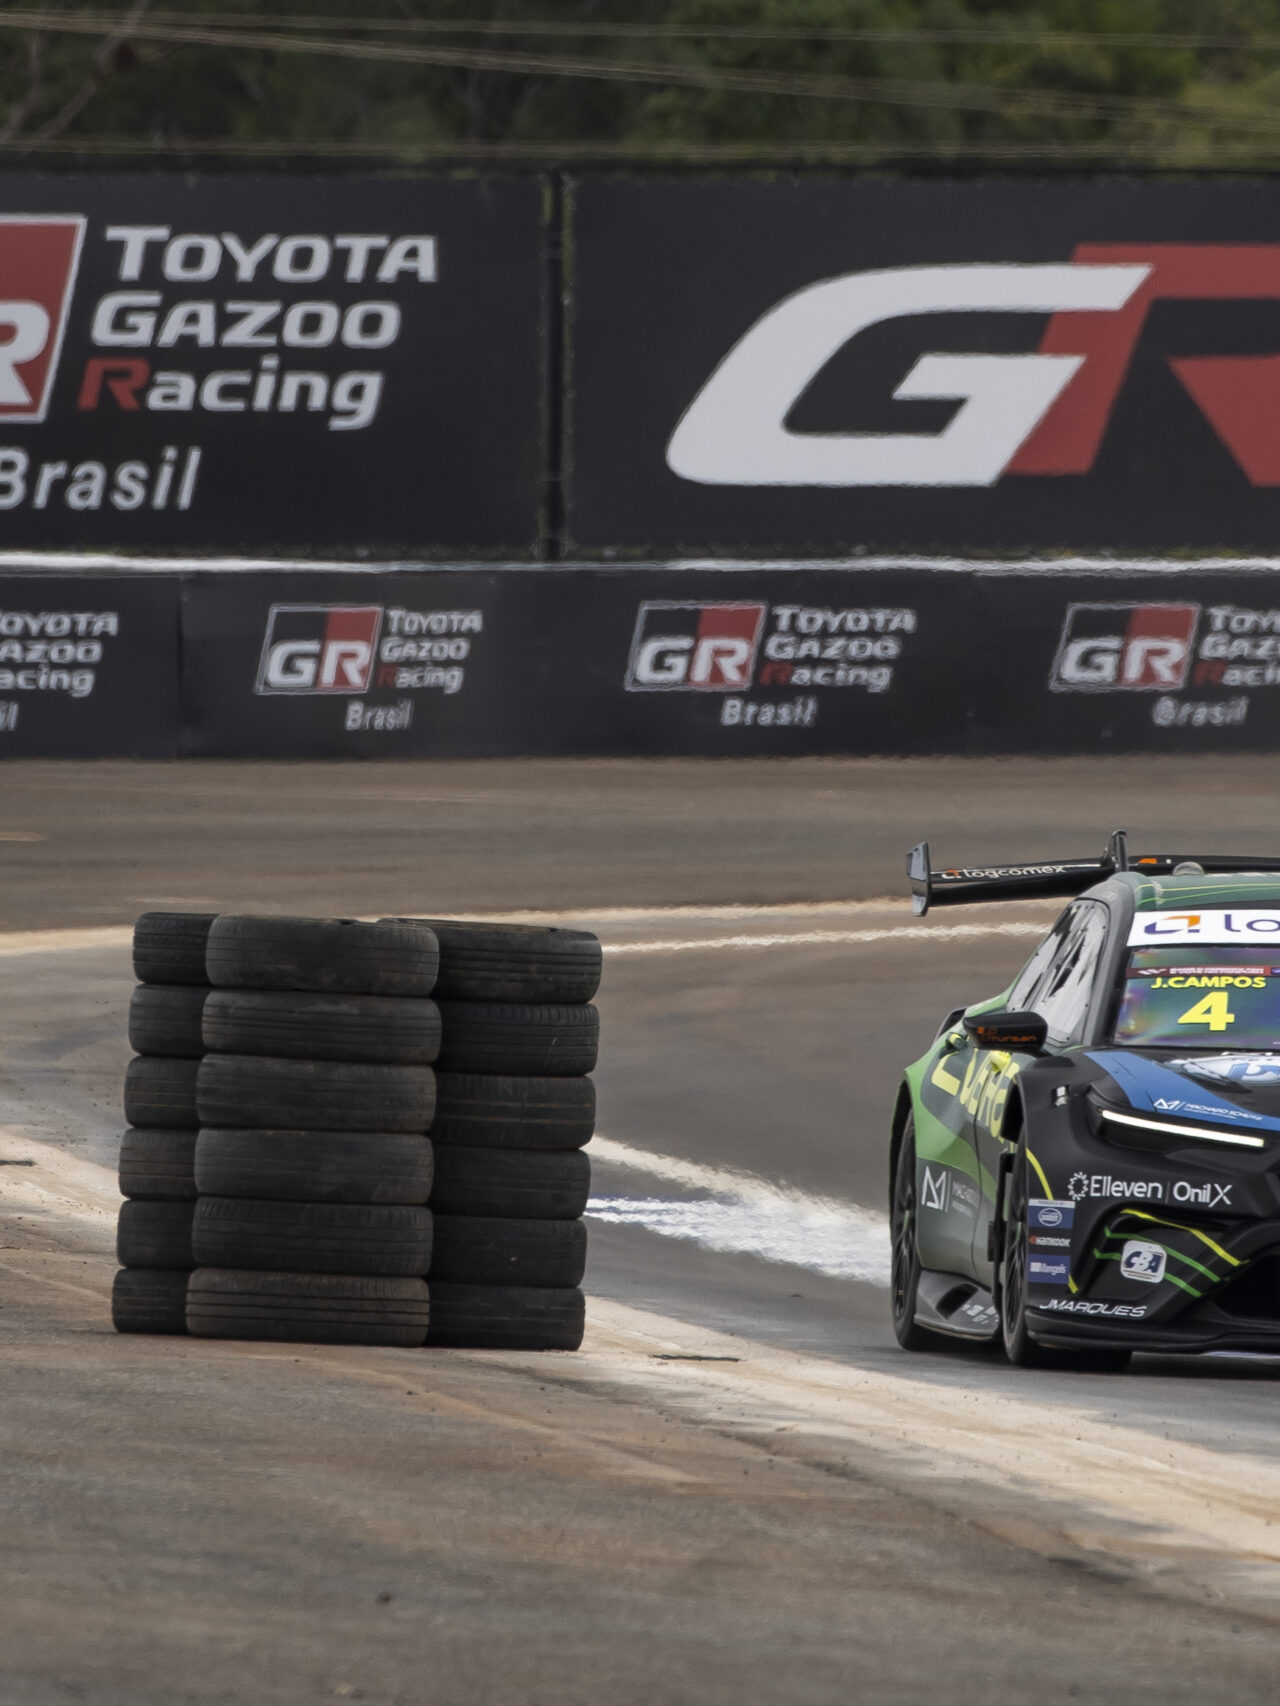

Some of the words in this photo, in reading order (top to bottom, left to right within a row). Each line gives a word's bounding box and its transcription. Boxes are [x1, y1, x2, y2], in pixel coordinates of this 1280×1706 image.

[105, 225, 439, 283] TOYOTA
[90, 290, 402, 347] GAZOO
[77, 354, 384, 430] Racing
[0, 611, 119, 636] OYOTA
[387, 609, 484, 634] TOYOTA
[771, 604, 918, 633] TOYOTA
[0, 639, 103, 663] AZOO
[381, 637, 471, 661] GAZOO
[635, 635, 752, 683] GR
[764, 633, 901, 660] GAZOO
[1060, 635, 1186, 683] GR
[266, 640, 371, 687] GR
[759, 659, 894, 692] Racing
[0, 660, 95, 698] acing
[378, 664, 464, 694] Racing
[345, 701, 413, 731] Brasil
[720, 696, 817, 726] Brasil
[1152, 695, 1249, 726] Brasil
[964, 864, 1066, 879] logcomex
[1150, 976, 1267, 989] J.CAMPOS
[1177, 991, 1235, 1031] 4
[1090, 1176, 1162, 1198] Elleven
[1125, 1251, 1163, 1274] CBA
[1040, 1299, 1147, 1317] JMARQUES
